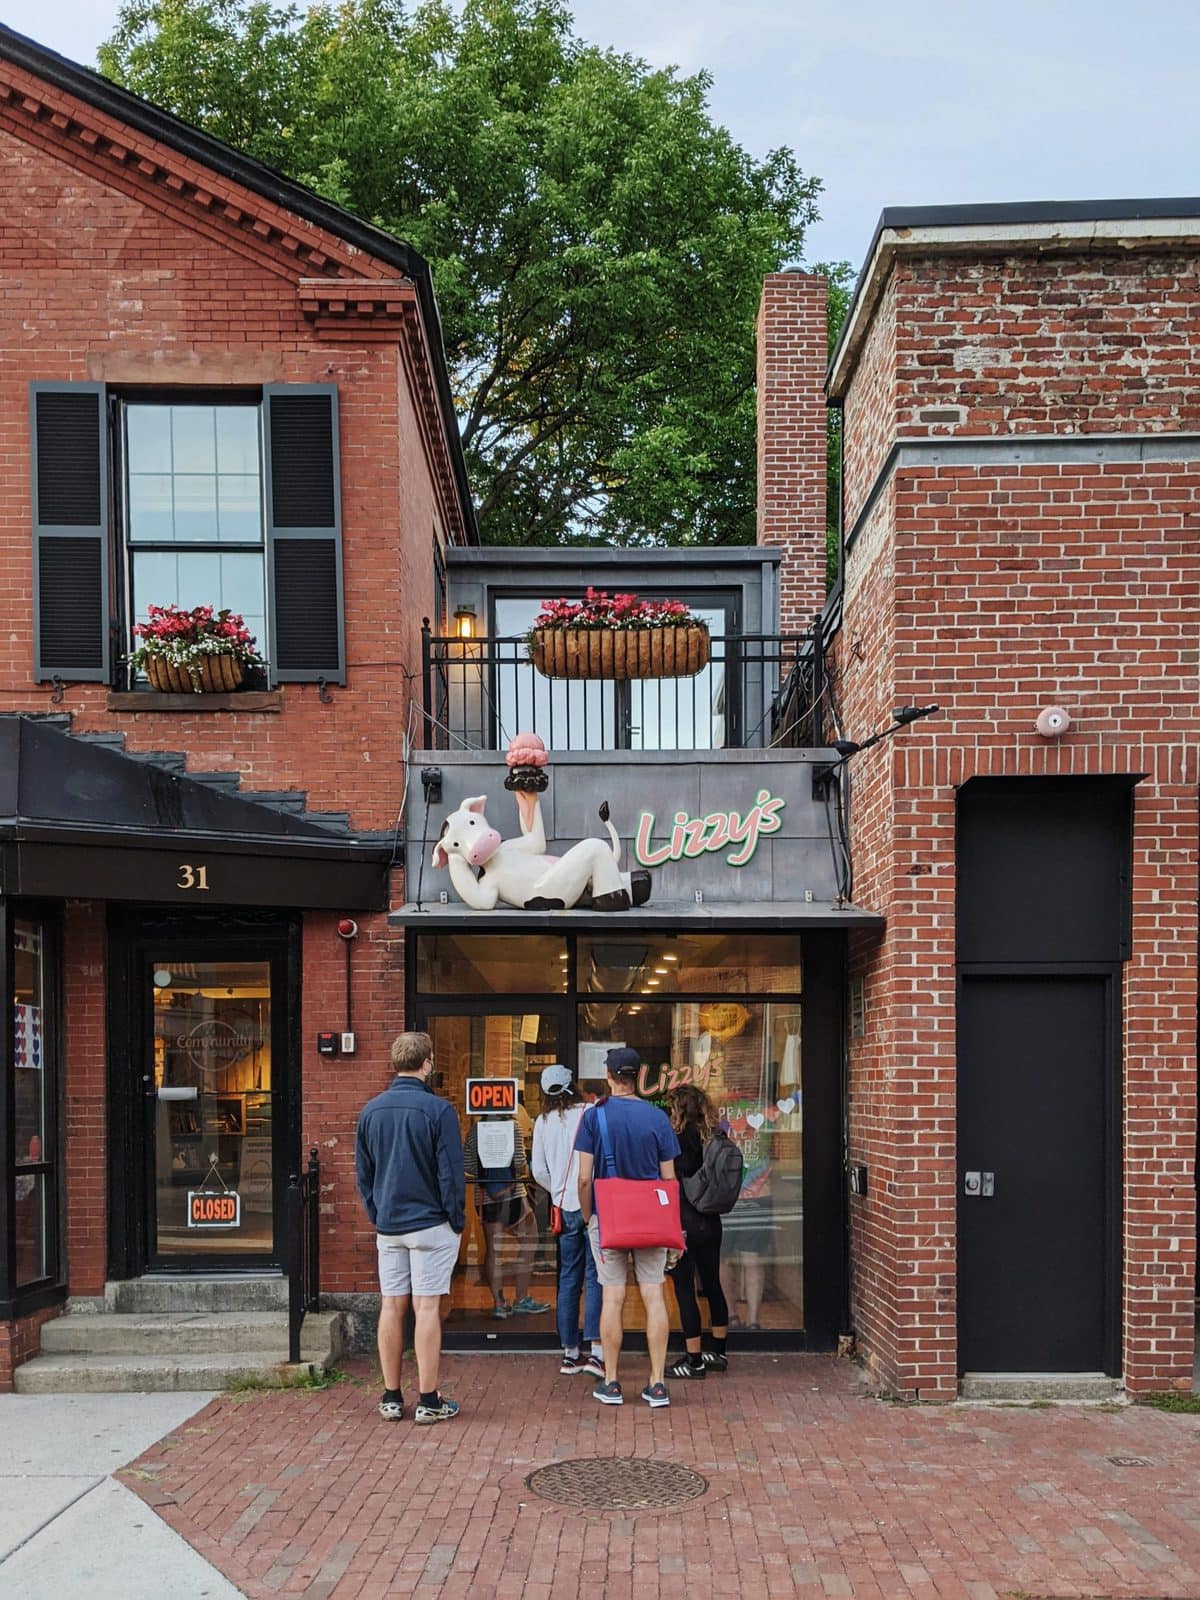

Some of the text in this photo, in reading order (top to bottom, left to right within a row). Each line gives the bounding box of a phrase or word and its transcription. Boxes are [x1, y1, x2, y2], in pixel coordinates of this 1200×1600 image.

[635, 789, 785, 867] Lizzy's
[177, 865, 209, 889] 31
[470, 1085, 514, 1107] OPEN
[192, 1198, 235, 1220] CLOSED
